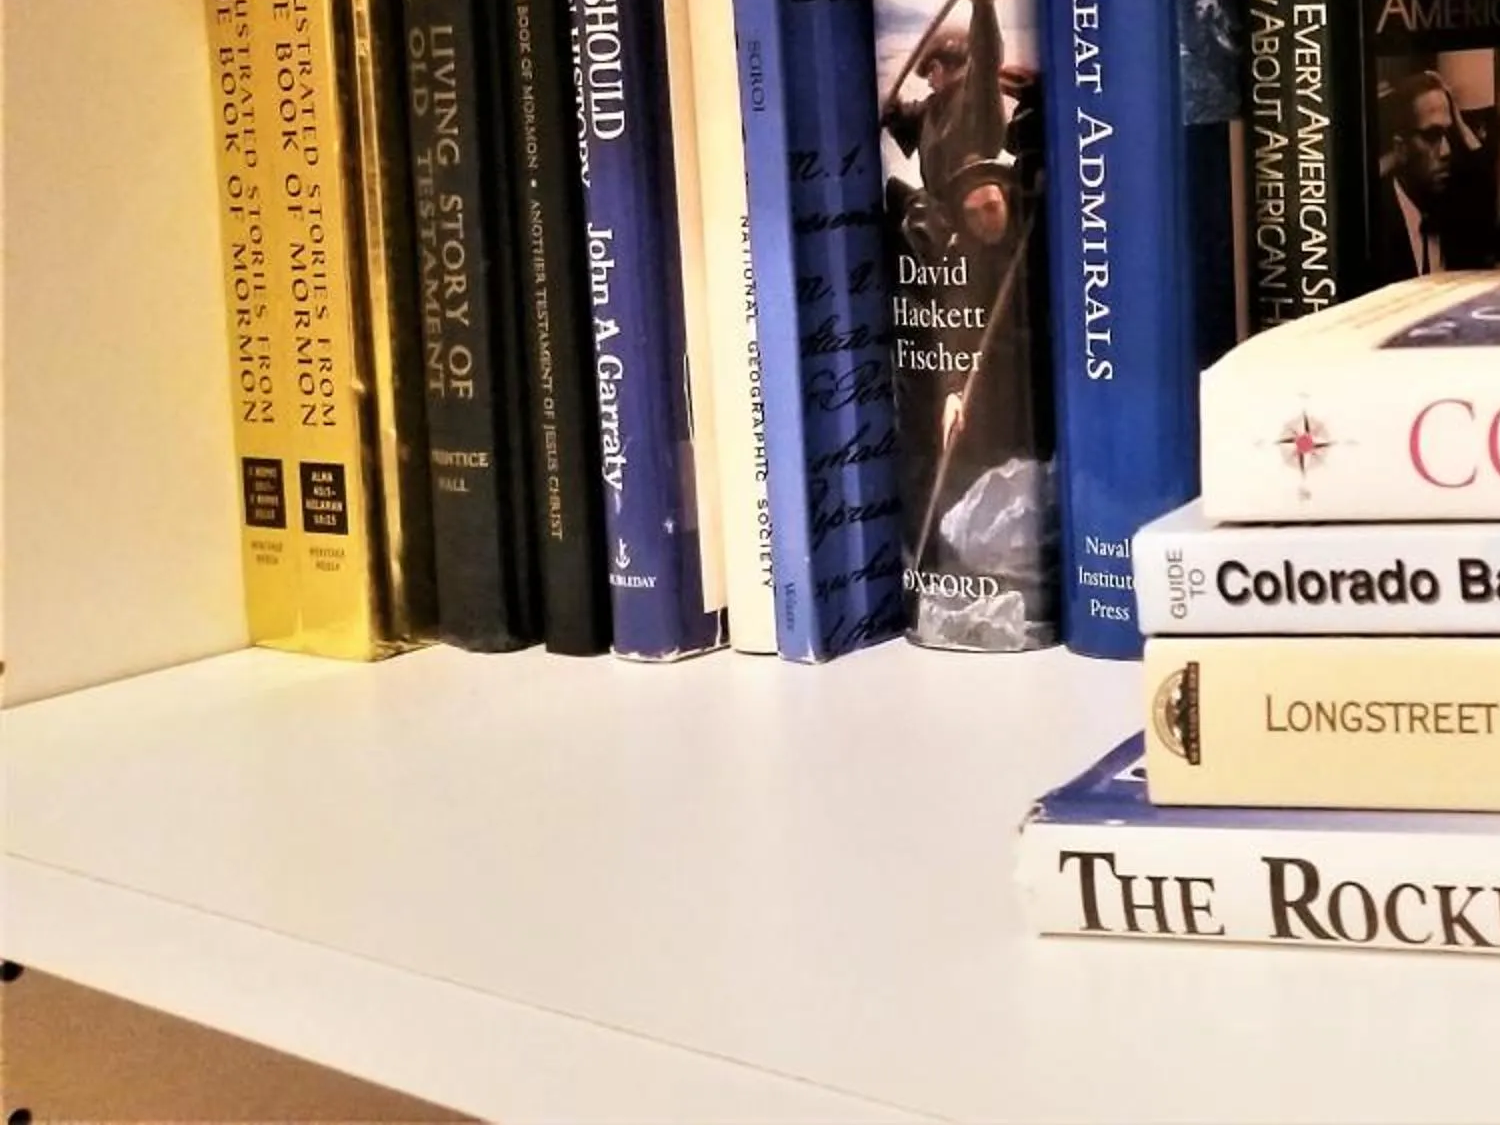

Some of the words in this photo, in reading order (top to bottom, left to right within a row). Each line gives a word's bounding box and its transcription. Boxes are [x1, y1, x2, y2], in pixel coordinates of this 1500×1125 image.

[410, 27, 431, 117] OLD
[517, 6, 532, 54] BOOK
[521, 58, 534, 80] OF
[1250, 8, 1286, 124] ABOUT
[1293, 2, 1328, 104] EVERY
[219, 47, 240, 152] BOOK
[275, 41, 299, 151] BOOK
[429, 25, 461, 166] LIVING
[522, 85, 539, 169] MORMON
[226, 173, 245, 224] OF
[285, 172, 304, 223] OF
[1254, 126, 1290, 289] AMERICAN
[1297, 104, 1331, 271] AMERICAN
[308, 183, 329, 320] STORIES
[416, 147, 446, 398] TESTAMENT
[439, 193, 470, 326] STORY
[530, 198, 546, 283] ANOTHER
[587, 222, 615, 306] John
[739, 215, 759, 324] NATIONAL
[899, 253, 968, 286] David
[1077, 106, 1114, 382] ADMIRALS
[231, 242, 258, 423] MORMON
[247, 185, 267, 320] STORIES
[257, 335, 275, 423] FROM
[290, 241, 318, 427] MORMON
[535, 286, 554, 390] TESTAMENT
[892, 295, 985, 328] Hackett
[317, 337, 336, 427] FROM
[450, 344, 474, 400] OF
[896, 337, 983, 372] Fischer
[543, 397, 556, 420] OF
[543, 424, 559, 473] JESUS
[597, 353, 627, 492] Garraty
[746, 340, 770, 482] GEOGRAPHIC
[549, 475, 563, 542] CHRIST
[756, 498, 774, 589] SOCIETY
[1085, 534, 1131, 559] Naval
[903, 568, 999, 598] OXFORD
[1090, 597, 1130, 621] Press
[1167, 548, 1189, 619] GUIDE
[1189, 568, 1206, 597] TO
[1215, 558, 1441, 605] Colorado
[1264, 693, 1499, 735] LONGSTREET
[1059, 849, 1226, 937] THE
